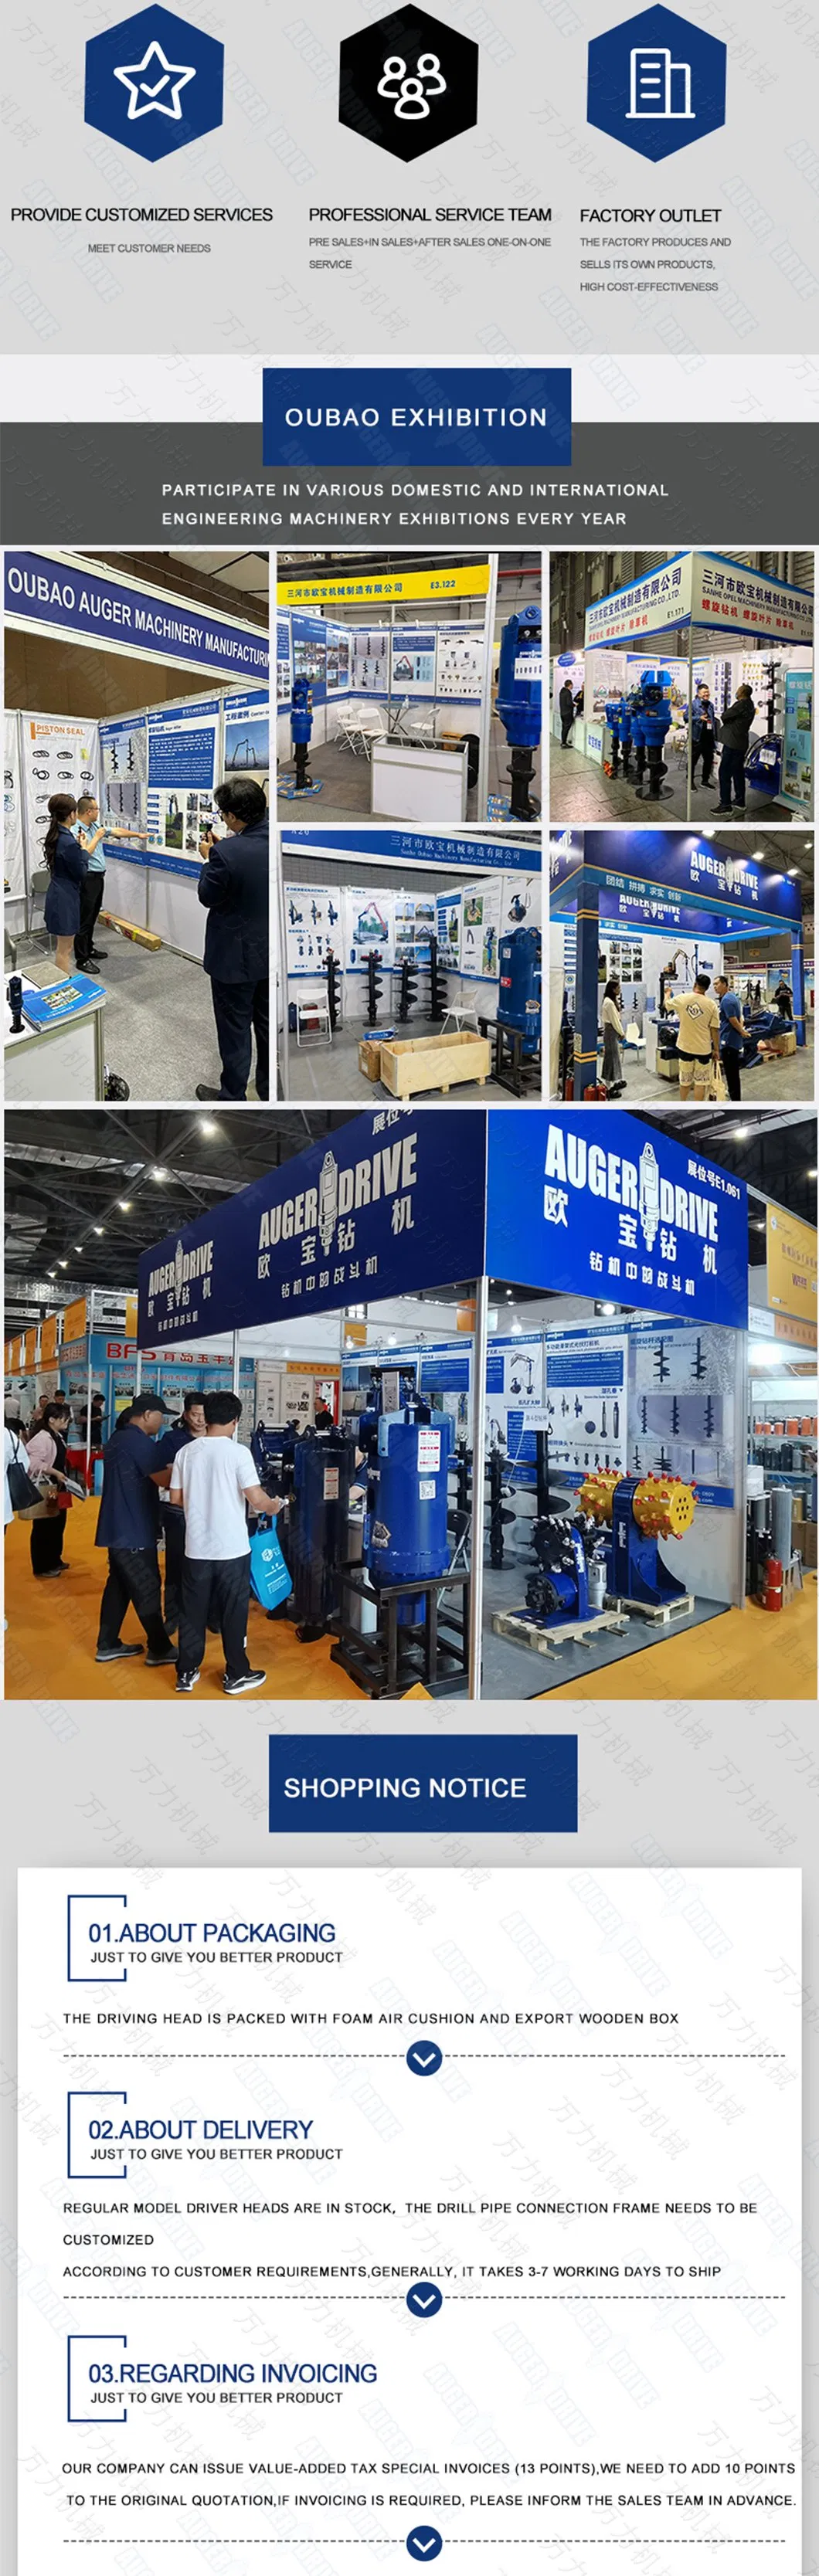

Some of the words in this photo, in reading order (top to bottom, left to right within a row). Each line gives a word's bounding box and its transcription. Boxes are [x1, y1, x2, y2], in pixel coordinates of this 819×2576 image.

[11, 208, 82, 222] PROVIDE
[85, 208, 190, 222] CUSTOMIZED
[193, 208, 274, 222] SERVICES
[309, 208, 432, 222] PROFESSIONAL
[435, 208, 505, 222] SERVICE
[508, 208, 552, 222] TEAM
[580, 209, 656, 222] FACTORY
[659, 209, 722, 222] OUTLET
[87, 243, 116, 253] MEET
[117, 243, 175, 253] CUSTOMER
[176, 243, 212, 253] NEEDS
[309, 237, 330, 247] PRE
[331, 237, 379, 247] SALES+IN
[381, 237, 451, 247] SALES+AFTER
[453, 237, 486, 247] SALES
[487, 237, 552, 247] ONE-ON-ONE
[579, 237, 600, 247] THE
[602, 237, 650, 247] FACTORY
[651, 237, 709, 247] PRODUCES
[709, 237, 732, 247] AND
[309, 260, 353, 270] SERVICE
[579, 260, 611, 270] SELLS
[613, 260, 629, 270] ITS
[630, 260, 655, 270] OWN
[657, 260, 715, 270] PRODUCTS,
[579, 282, 605, 292] HIGH
[607, 282, 719, 292] COST-EFFECTIVENESS
[285, 408, 379, 427] OUBAO
[392, 408, 546, 427] EXHIBITION
[162, 484, 276, 497] PARTICIPATE
[283, 484, 300, 497] IN
[306, 484, 384, 497] VARIOUS
[391, 484, 481, 497] DOMESTIC
[487, 484, 523, 497] AND
[530, 484, 669, 497] INTERNATIONAL
[162, 512, 282, 525] ENGINEERING
[290, 512, 392, 525] MACHINERY
[399, 512, 510, 525] EXHIBITIONS
[517, 512, 574, 525] EVERY
[580, 512, 627, 525] YEAR
[287, 582, 403, 598] 三河市欧宝机械制造有限公司
[430, 579, 456, 590] E3.122
[702, 585, 722, 599] SANHE
[8, 567, 76, 609] OUBAO
[78, 591, 132, 627] AUGER
[134, 608, 204, 648] MACHINERY
[36, 724, 66, 734] PISTON
[66, 727, 86, 735] SEAL
[390, 834, 521, 861] 三河市欧宝机械制造有限公司
[690, 850, 726, 879] AUGER
[734, 867, 759, 891] DRIVE
[605, 874, 625, 889] 团结
[545, 1124, 638, 1211] AUGER
[659, 1176, 719, 1244] DRIVE
[258, 1186, 319, 1251] AUGER
[338, 1132, 418, 1217] DRIVE
[148, 1261, 176, 1298] AUGER
[182, 1240, 214, 1283] DRIVE
[589, 1250, 695, 1297] 钻机中的战斗机
[281, 1255, 378, 1299] 钻机中的战斗机
[284, 1777, 420, 1798] SHOPPING
[430, 1777, 527, 1798] NOTICE
[89, 1923, 198, 1943] 01.ABOUT
[203, 1923, 335, 1943] PACKAGING
[90, 1951, 124, 1963] JUST
[127, 1951, 147, 1963] TO
[151, 1951, 182, 1963] GIVE
[186, 1951, 216, 1963] YOU
[219, 1952, 273, 1963] BETTER
[277, 1951, 343, 1963] PRODUCT
[89, 2120, 198, 2140] 02.ABOUT
[203, 2120, 314, 2140] DELIVERY
[63, 2234, 155, 2245] CUSTOMIZED
[63, 2265, 147, 2277] ACCORDING
[151, 2265, 170, 2277] TO
[174, 2265, 252, 2277] CUSTOMER
[257, 2265, 457, 2279] REQUIREMENTS,GENERALLY,
[462, 2266, 474, 2277] IT
[479, 2265, 524, 2277] TAKES
[528, 2266, 549, 2277] 3-7
[552, 2265, 620, 2278] WORKING
[624, 2265, 661, 2277] DAYS
[665, 2265, 685, 2277] TO
[688, 2265, 722, 2278] SHIP
[88, 2364, 255, 2384] 03.REGARDING
[262, 2364, 377, 2384] INVOICING
[62, 2462, 92, 2474] OUR
[97, 2462, 165, 2474] COMPANY
[169, 2462, 198, 2474] CAN
[203, 2462, 243, 2474] ISSUE
[248, 2463, 346, 2474] VALUE-ADDED
[351, 2463, 377, 2474] TAX
[382, 2462, 440, 2474] SPECIAL
[444, 2462, 510, 2474] INVOICES
[515, 2463, 535, 2476] (13
[540, 2462, 621, 2476] POINTS),WE
[627, 2463, 664, 2474] NEED
[668, 2462, 687, 2474] TO
[691, 2463, 720, 2474] ADD
[725, 2463, 740, 2474] 10
[745, 2462, 796, 2474] POINTS
[66, 2495, 86, 2506] TO
[90, 2495, 117, 2506] THE
[121, 2494, 187, 2506] ORIGINAL
[192, 2495, 290, 2507] QUOTATION,IF
[294, 2495, 367, 2506] INVOICING
[371, 2495, 385, 2506] IS
[389, 2495, 465, 2507] REQUIRED,
[470, 2495, 523, 2506] PLEASE
[528, 2495, 581, 2506] INFORM
[586, 2495, 613, 2506] THE
[617, 2495, 662, 2506] SALES
[666, 2495, 704, 2506] TEAM
[709, 2495, 722, 2506] IN
[726, 2495, 797, 2506] ADVANCE.
